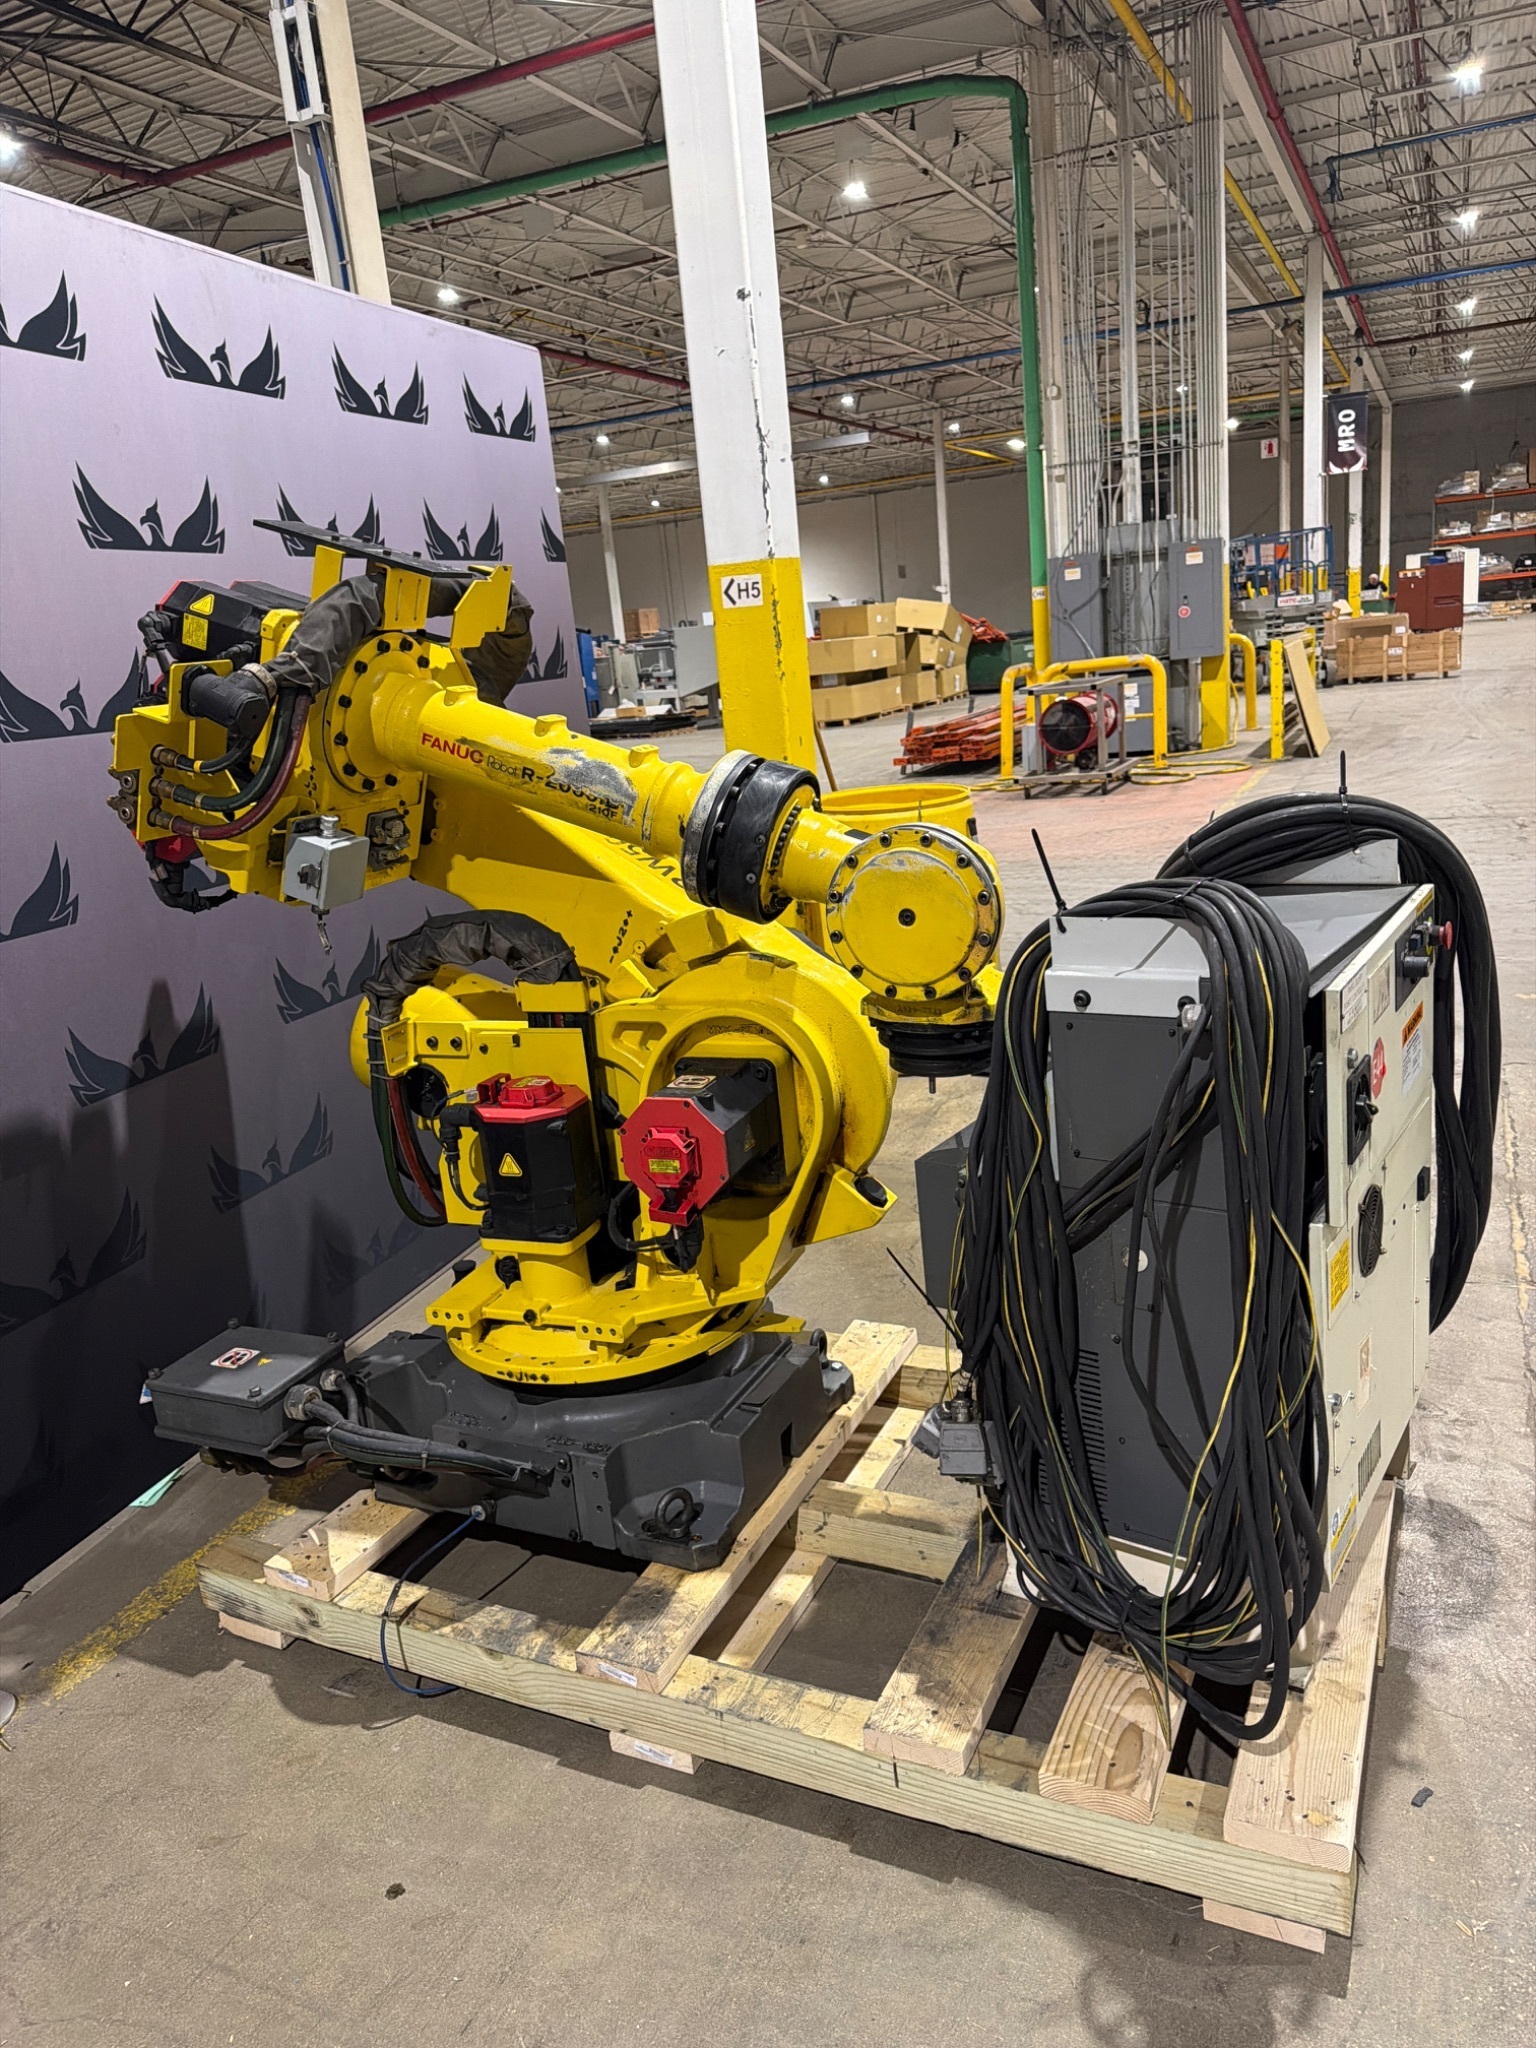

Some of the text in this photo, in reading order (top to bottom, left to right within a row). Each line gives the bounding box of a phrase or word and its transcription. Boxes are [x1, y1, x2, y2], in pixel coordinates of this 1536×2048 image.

[1337, 408, 1356, 453] MRO
[737, 581, 761, 600] H5
[421, 732, 484, 764] FANUC
[486, 754, 518, 776] Robot
